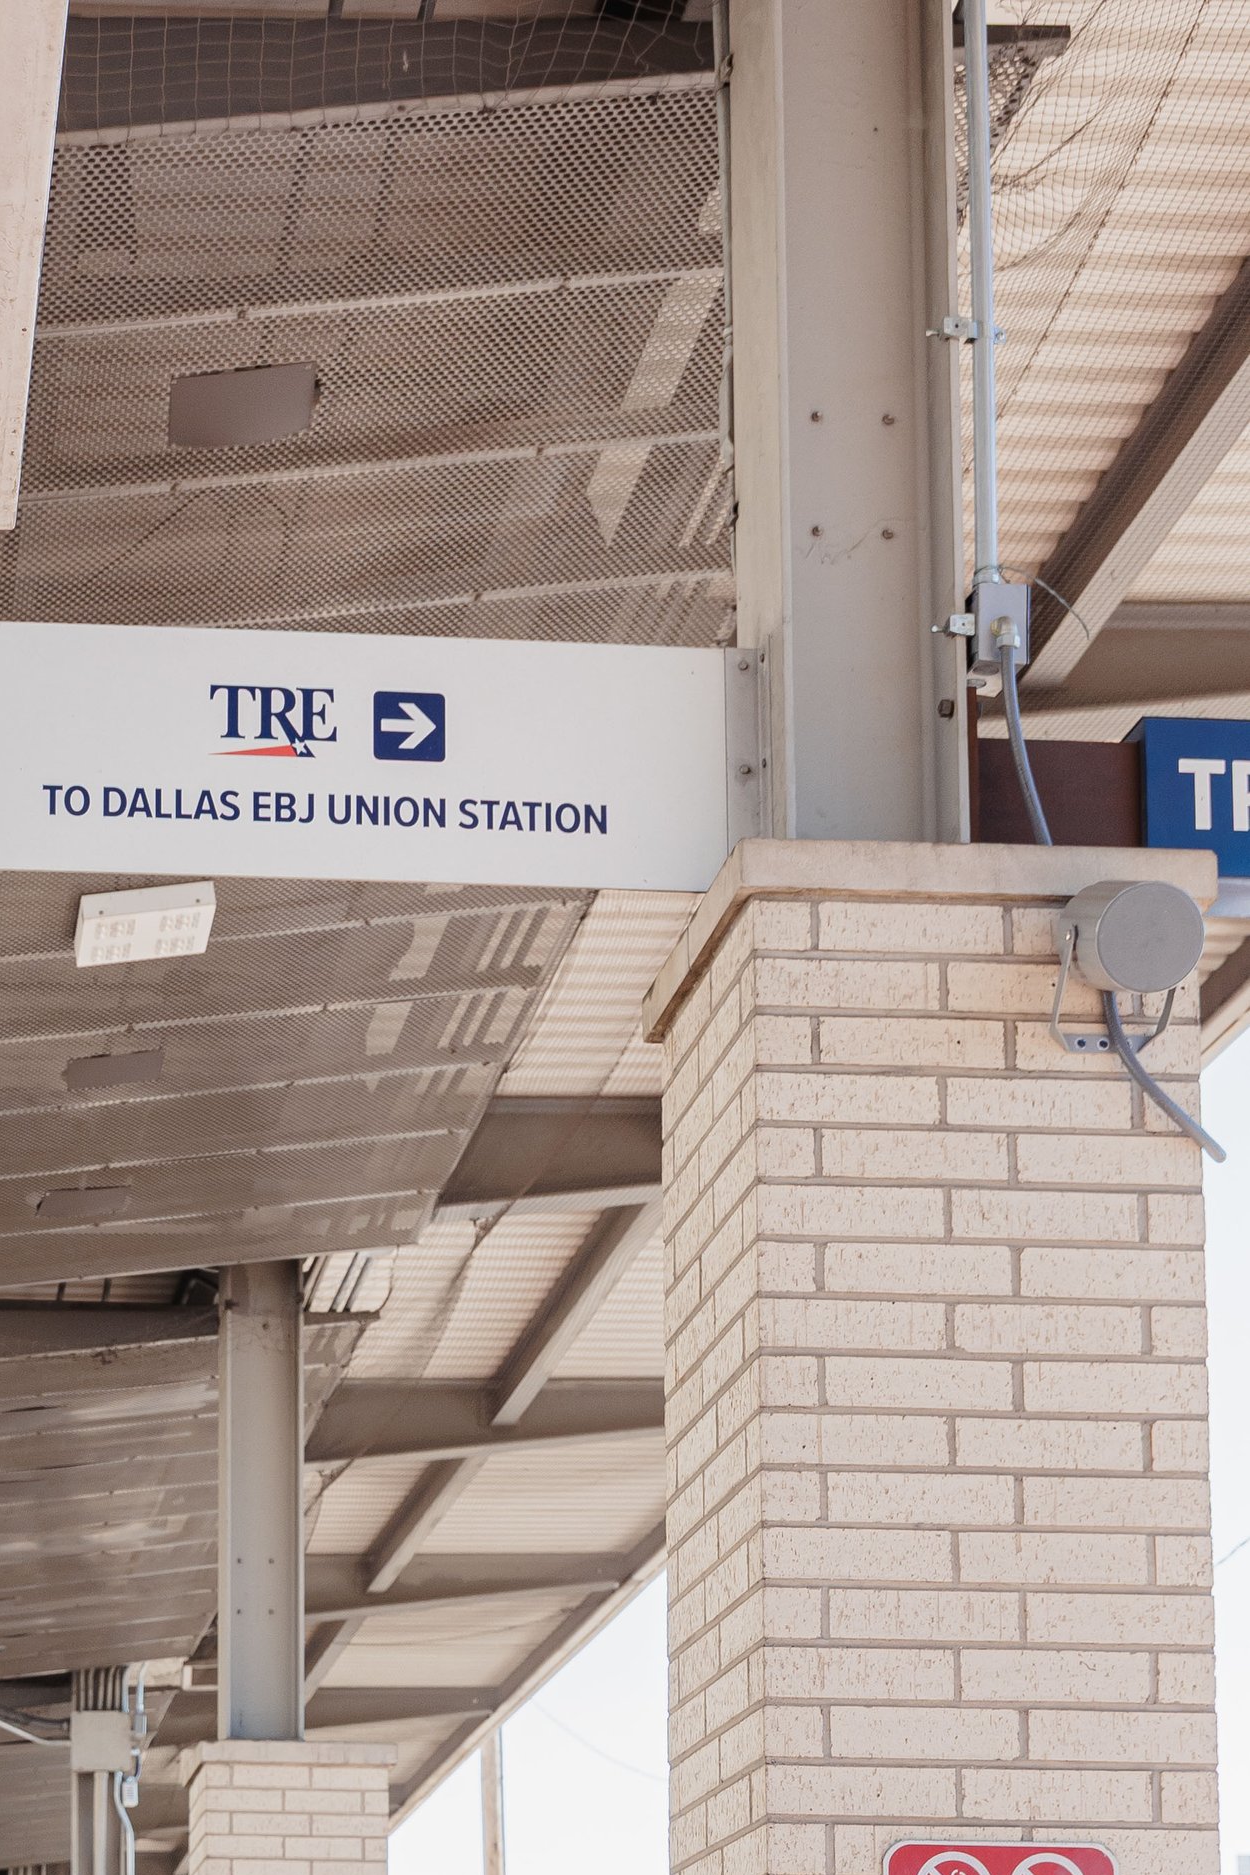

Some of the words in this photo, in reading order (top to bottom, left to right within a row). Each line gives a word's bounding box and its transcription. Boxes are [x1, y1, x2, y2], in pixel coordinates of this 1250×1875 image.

[209, 684, 338, 757] TRE
[42, 784, 91, 817] TO
[102, 786, 241, 821] DALLAS
[252, 791, 316, 824] EBJ
[328, 794, 447, 828] UNION
[458, 798, 609, 835] STATION
